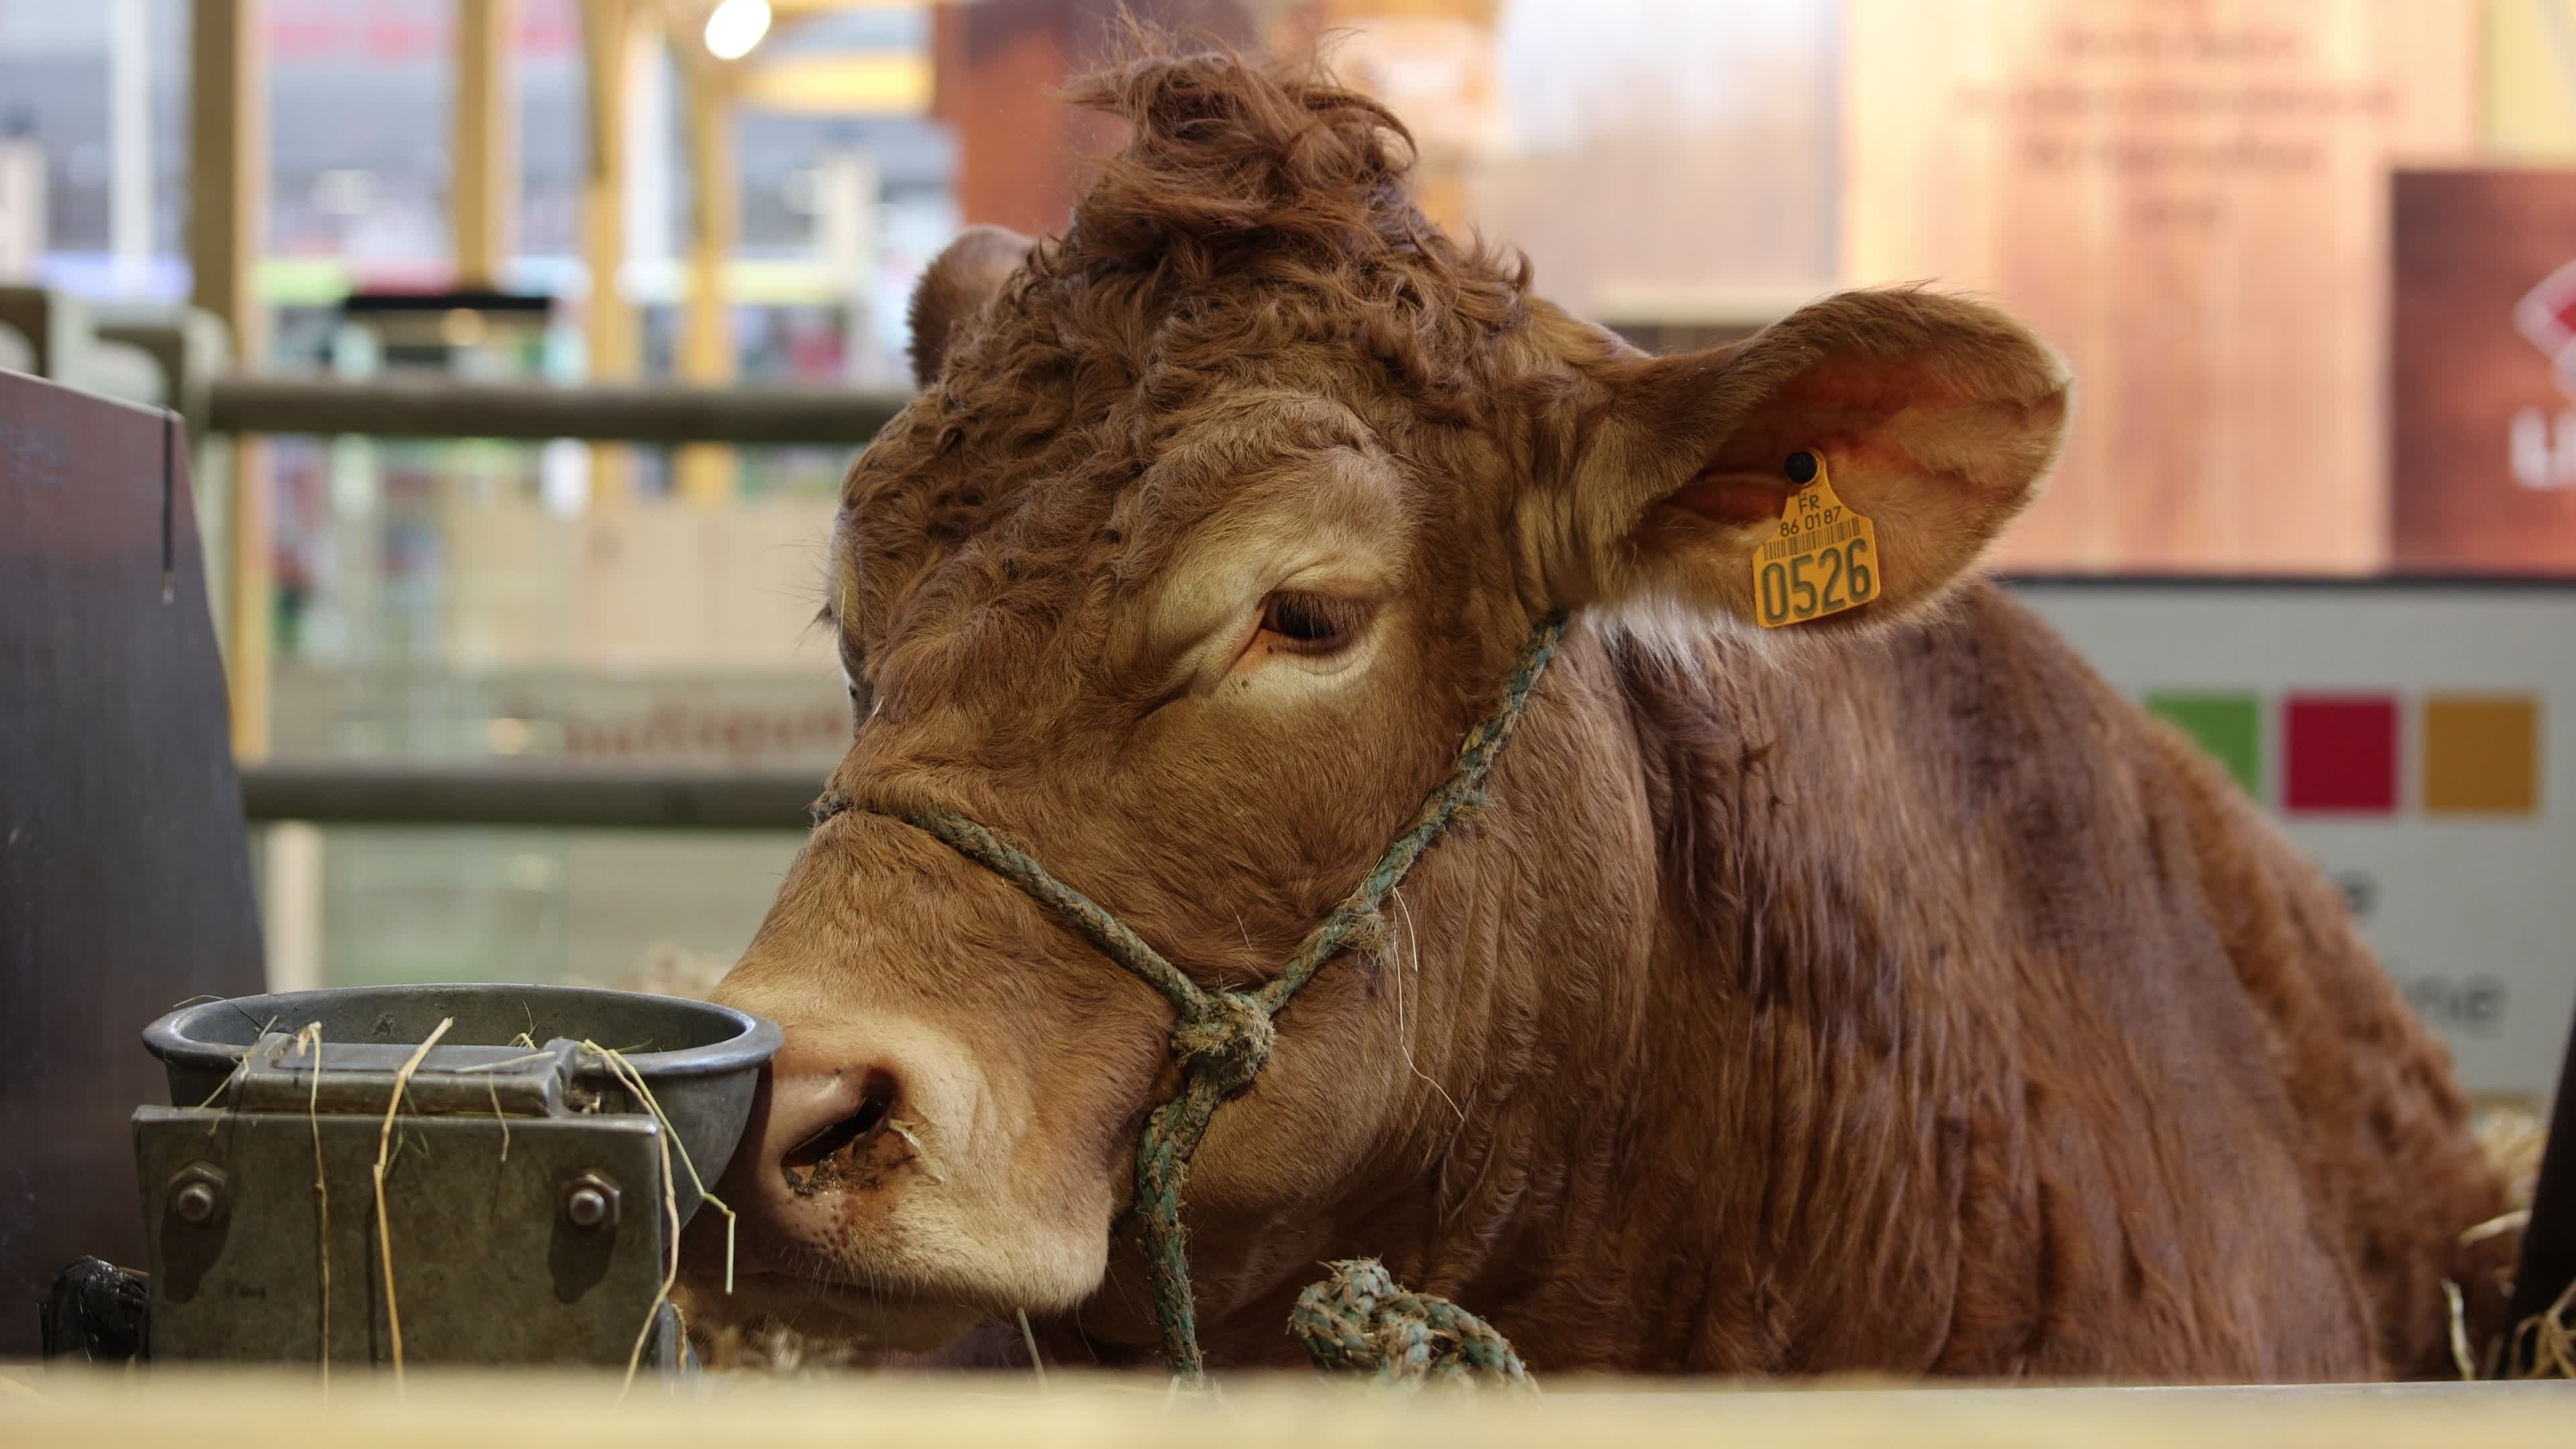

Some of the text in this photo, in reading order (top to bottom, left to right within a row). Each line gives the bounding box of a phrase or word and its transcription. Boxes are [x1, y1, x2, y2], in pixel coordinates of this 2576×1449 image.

[1798, 494, 1821, 515] FR
[1780, 505, 1841, 537] 86 0187
[1761, 538, 1871, 625] 0526
